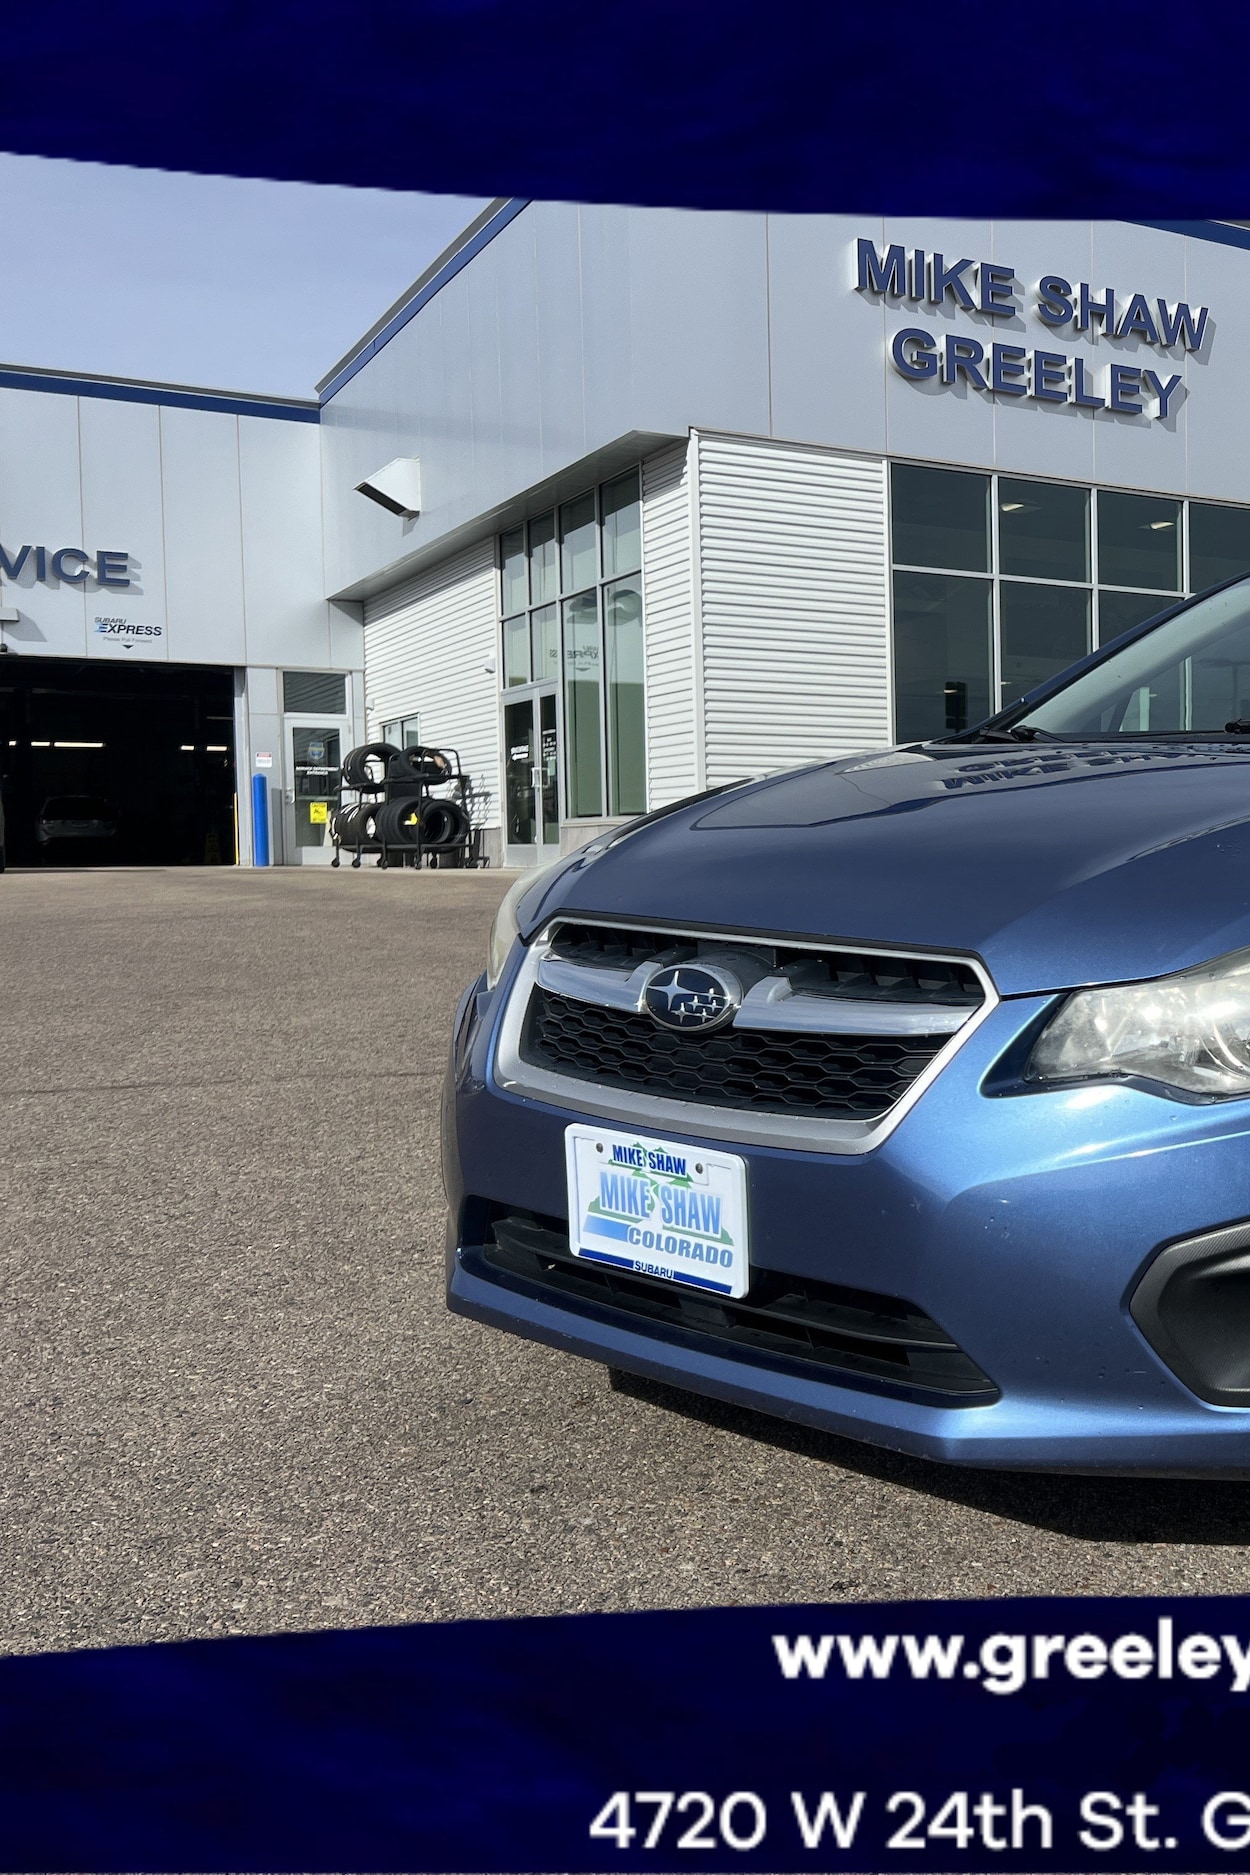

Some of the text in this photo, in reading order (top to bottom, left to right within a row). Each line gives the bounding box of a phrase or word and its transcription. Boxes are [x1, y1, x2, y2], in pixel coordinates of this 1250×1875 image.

[854, 238, 1209, 351] MIKE SHAW
[889, 328, 1183, 419] GREELEY
[0, 543, 131, 587] VICE
[94, 617, 127, 625] SUBARU
[95, 623, 162, 636] EXPRESS
[612, 1144, 686, 1176] MIKE SHAW
[601, 1172, 721, 1235] MIKE SHAW
[628, 1226, 733, 1268] COLORADO
[634, 1261, 674, 1279] SUBARU
